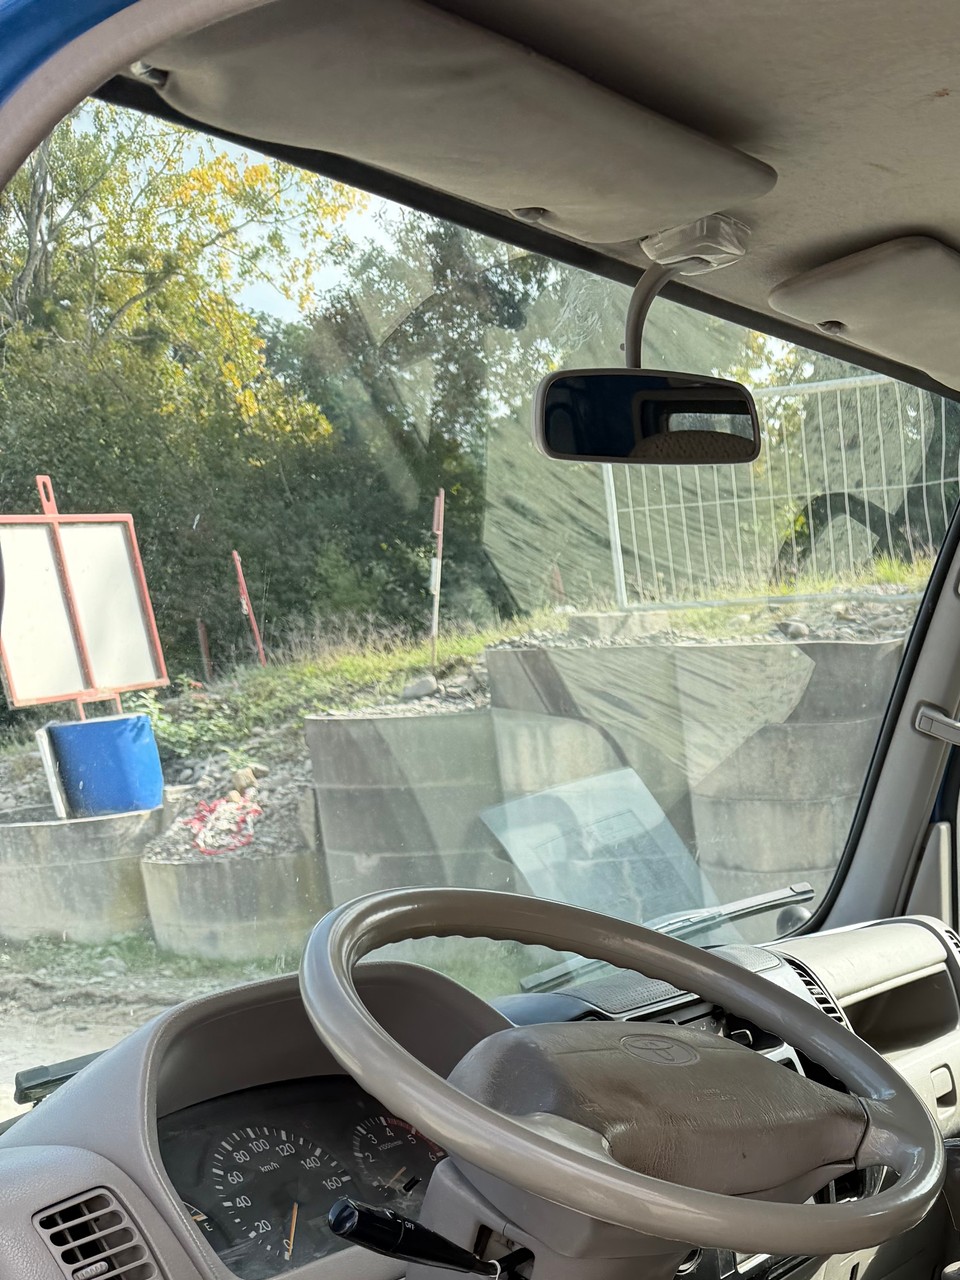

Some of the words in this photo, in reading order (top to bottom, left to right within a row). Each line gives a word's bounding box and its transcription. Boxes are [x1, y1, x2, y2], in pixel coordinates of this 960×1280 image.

[385, 1127, 394, 1137] 4
[367, 1134, 378, 1144] 3
[407, 1134, 416, 1144] 5
[248, 1139, 270, 1153] 100
[275, 1143, 296, 1157] 120
[233, 1150, 250, 1163] 80
[365, 1152, 375, 1162] 2
[428, 1151, 437, 1161] 6
[260, 1161, 280, 1173] km/h
[300, 1156, 321, 1170] 140
[227, 1171, 244, 1184] 60
[322, 1176, 342, 1190] 160
[236, 1195, 252, 1208] 40
[203, 1222, 213, 1232] E
[254, 1219, 272, 1233] 20
